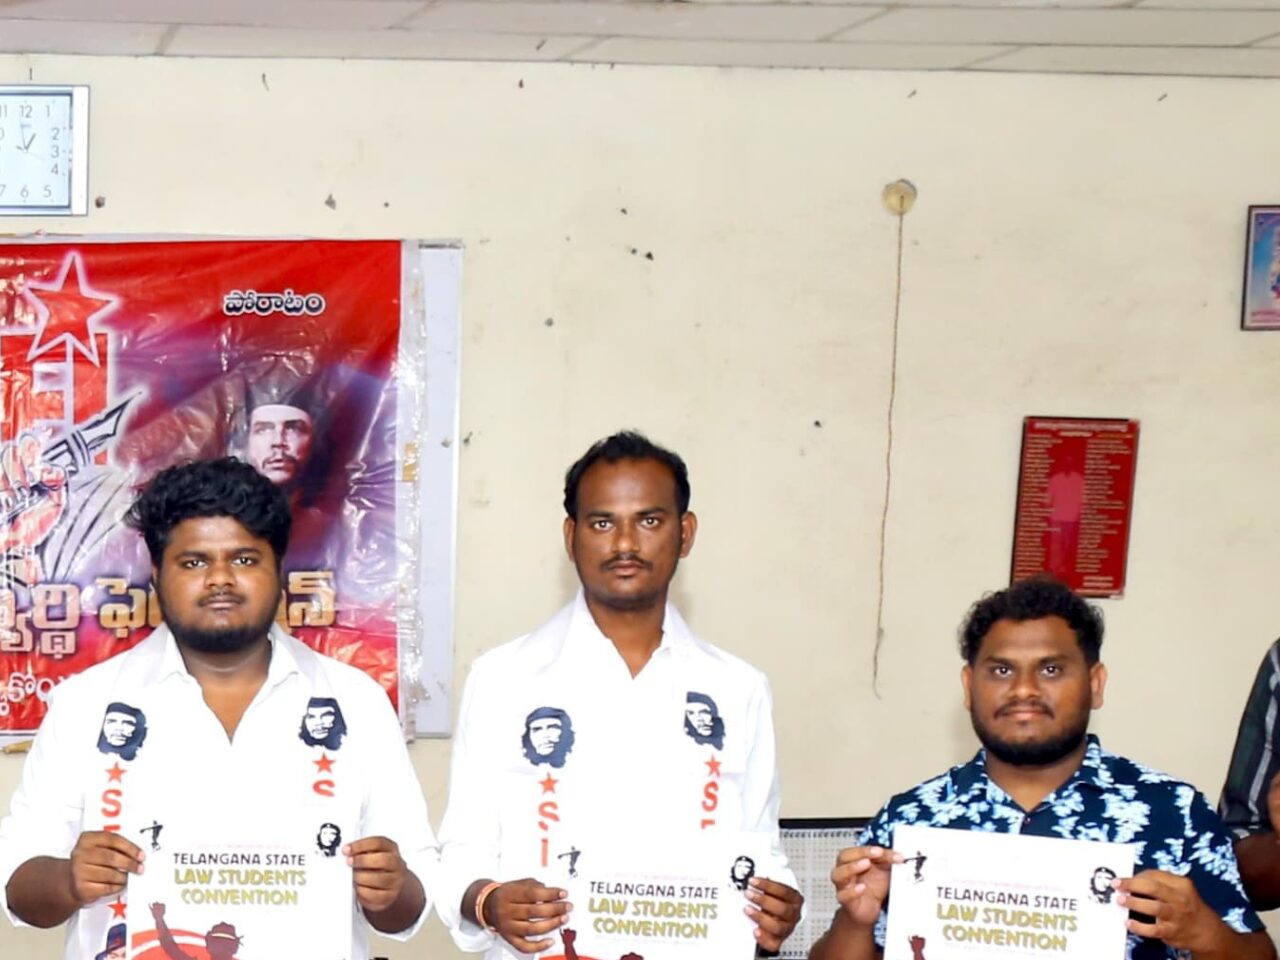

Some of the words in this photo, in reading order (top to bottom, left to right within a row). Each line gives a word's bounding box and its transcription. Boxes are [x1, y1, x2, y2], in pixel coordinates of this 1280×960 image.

[0, 105, 8, 118] 11
[20, 105, 33, 118] 12
[45, 105, 51, 118] 1
[51, 127, 60, 141] 2
[51, 145, 60, 158] 3
[51, 163, 59, 175] 4
[20, 184, 29, 198] 6
[43, 184, 52, 198] 5
[224, 289, 326, 316] పోరాటం
[173, 853, 260, 866] TELANGANA
[266, 854, 305, 866] STATE
[174, 869, 213, 885] LAW
[218, 869, 306, 886] STUDENTS
[181, 889, 298, 905] CONVENTION
[590, 881, 675, 897] TELANGANA
[680, 886, 719, 899] STATE
[937, 887, 1029, 907] TELANGANA
[1034, 895, 1078, 911] STATE
[588, 898, 628, 915] LAW
[632, 900, 718, 920] STUDENTS
[937, 903, 978, 922] LAW
[982, 908, 1078, 932] STUDENTS
[593, 917, 708, 939] CONVENTION
[942, 924, 1068, 951] CONVENTION
